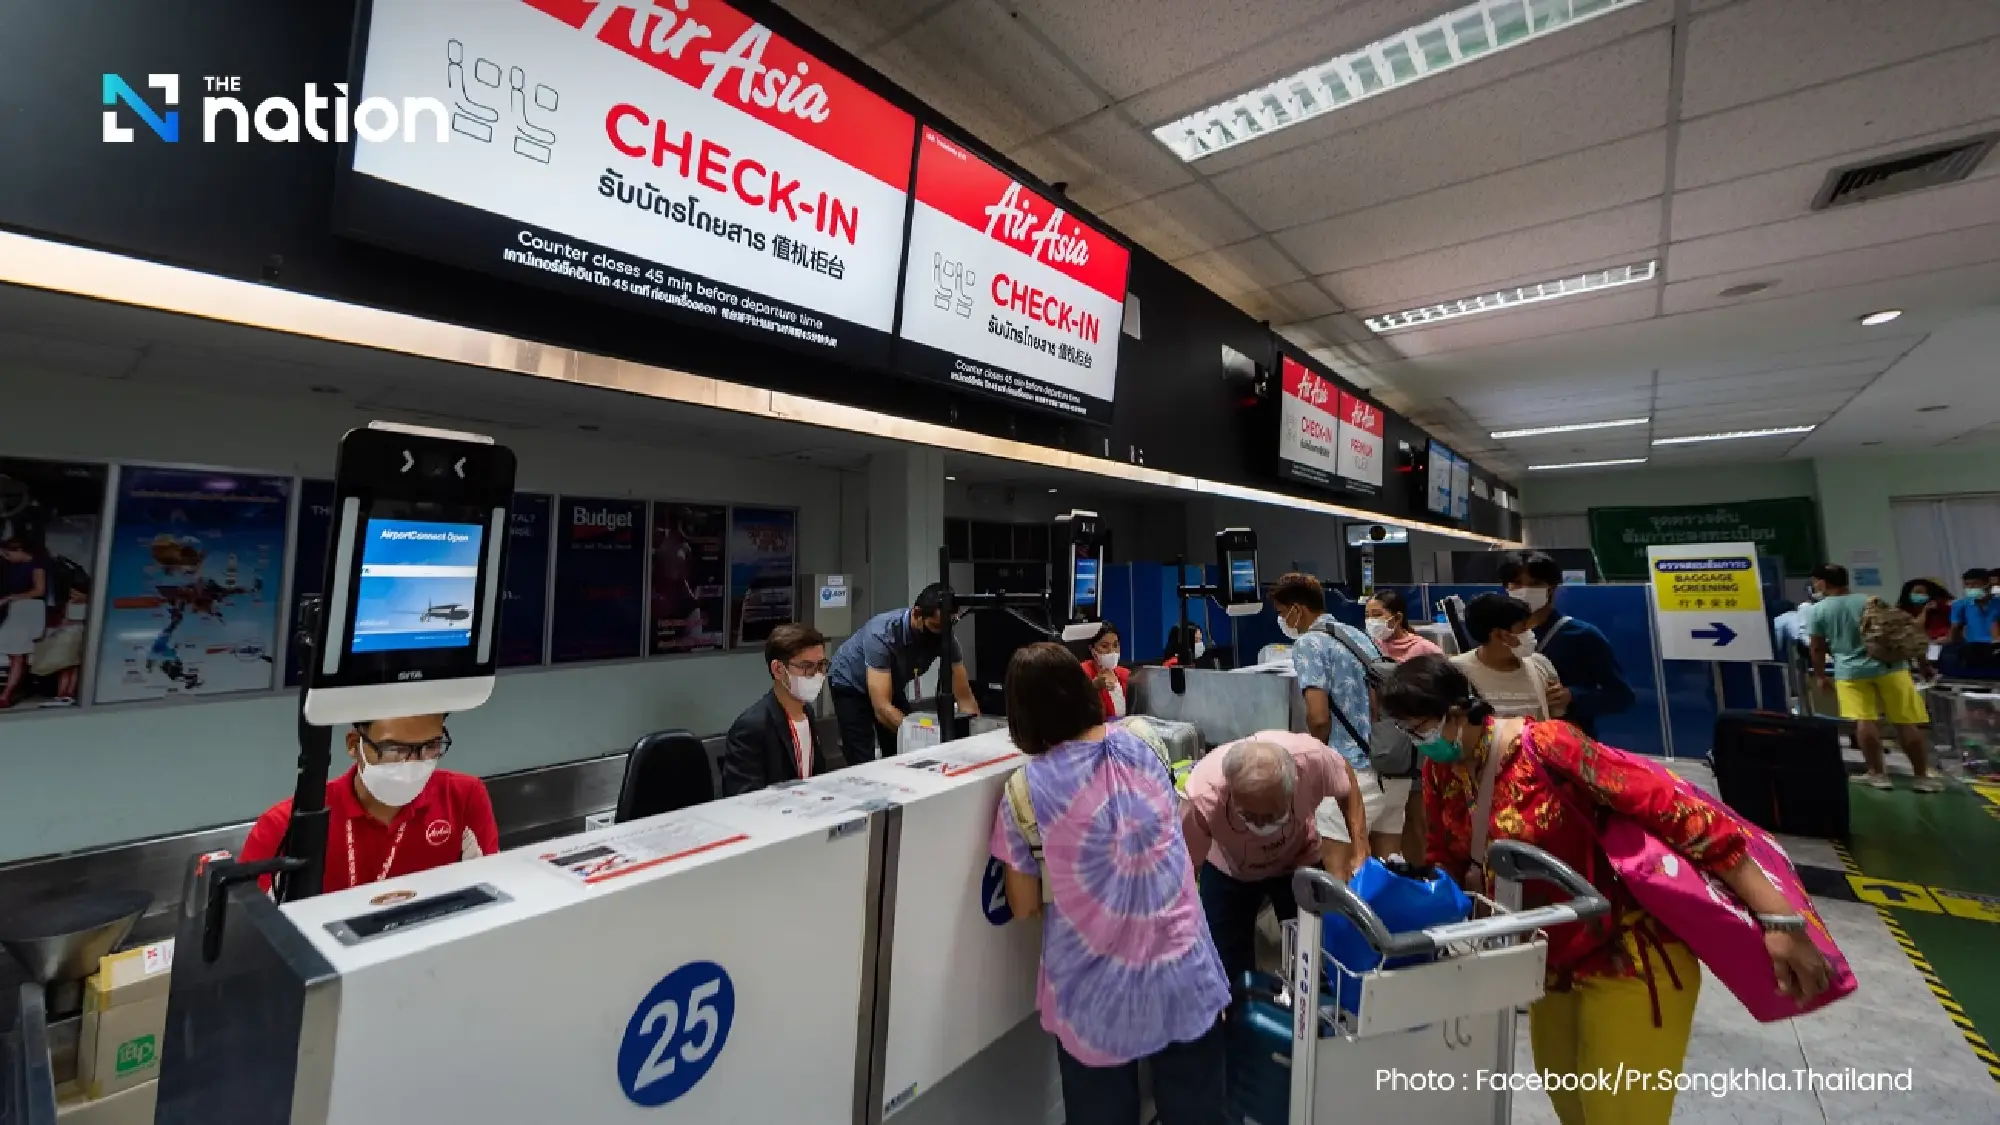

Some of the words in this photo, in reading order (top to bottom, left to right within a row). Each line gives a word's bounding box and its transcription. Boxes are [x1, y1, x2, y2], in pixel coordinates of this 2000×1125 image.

[605, 103, 859, 246] CHECK-IN
[597, 167, 766, 252] รับบัตรโดยสาร
[771, 233, 846, 281] 值机柜台
[517, 230, 589, 263] Counter
[592, 253, 641, 278] closes
[645, 267, 664, 284] 45
[667, 275, 693, 293] min
[696, 281, 738, 306] before
[741, 296, 798, 323] departure
[799, 313, 824, 330] time
[612, 277, 629, 293] 45
[990, 272, 1101, 345] CHECK-IN
[447, 531, 469, 543] Open
[572, 505, 633, 532] Budget
[1673, 583, 1739, 593] SCREENING
[1674, 574, 1734, 583] BAGGAGE
[633, 976, 721, 1092] 25
